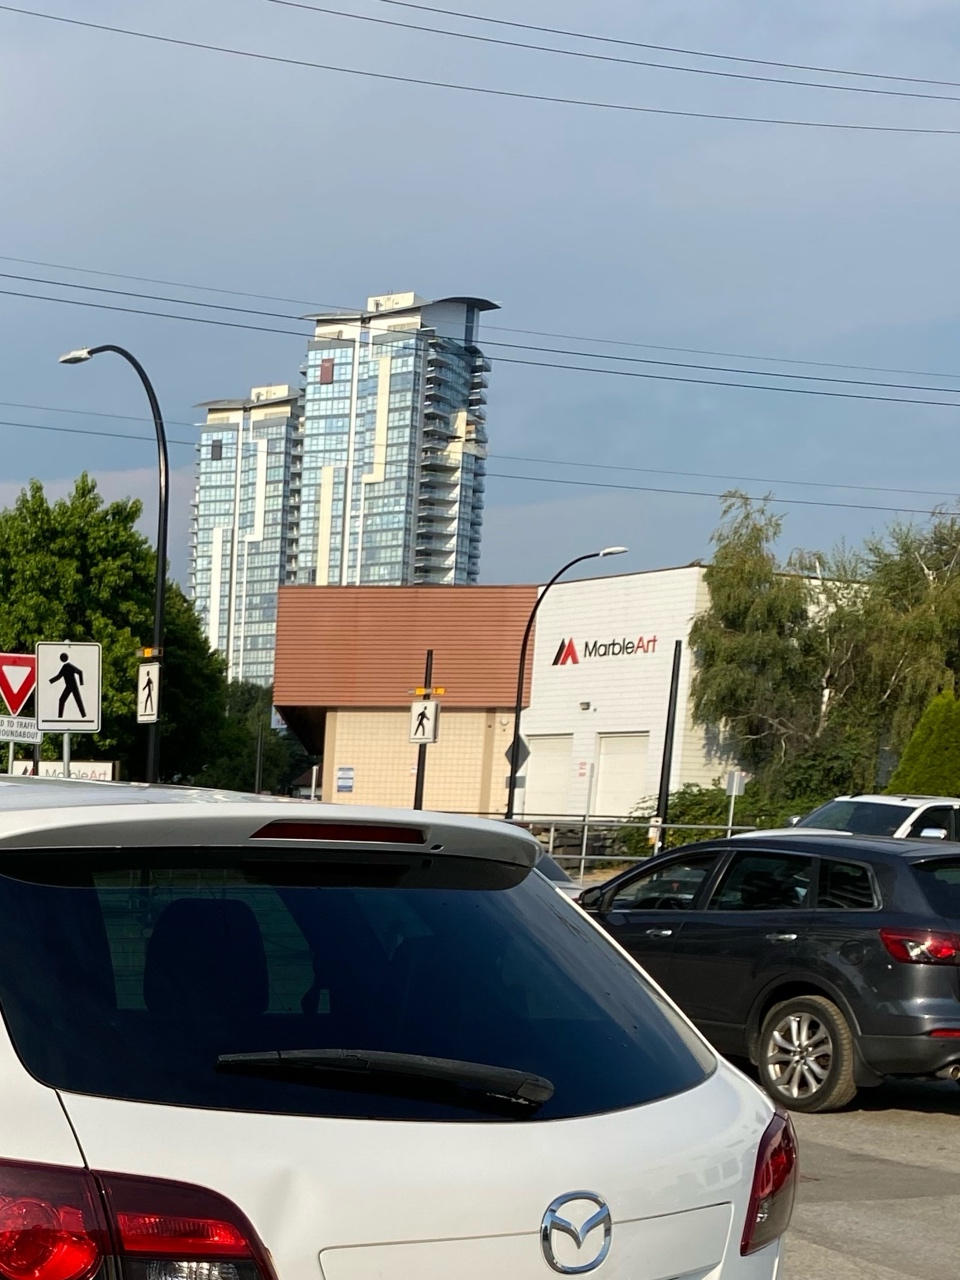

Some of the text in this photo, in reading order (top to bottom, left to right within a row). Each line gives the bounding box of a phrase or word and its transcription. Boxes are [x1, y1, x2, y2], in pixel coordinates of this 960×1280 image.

[584, 635, 657, 657] MarbleArt
[7, 720, 15, 728] TO
[16, 721, 36, 730] TRAFFI
[45, 769, 107, 780] MableArt
